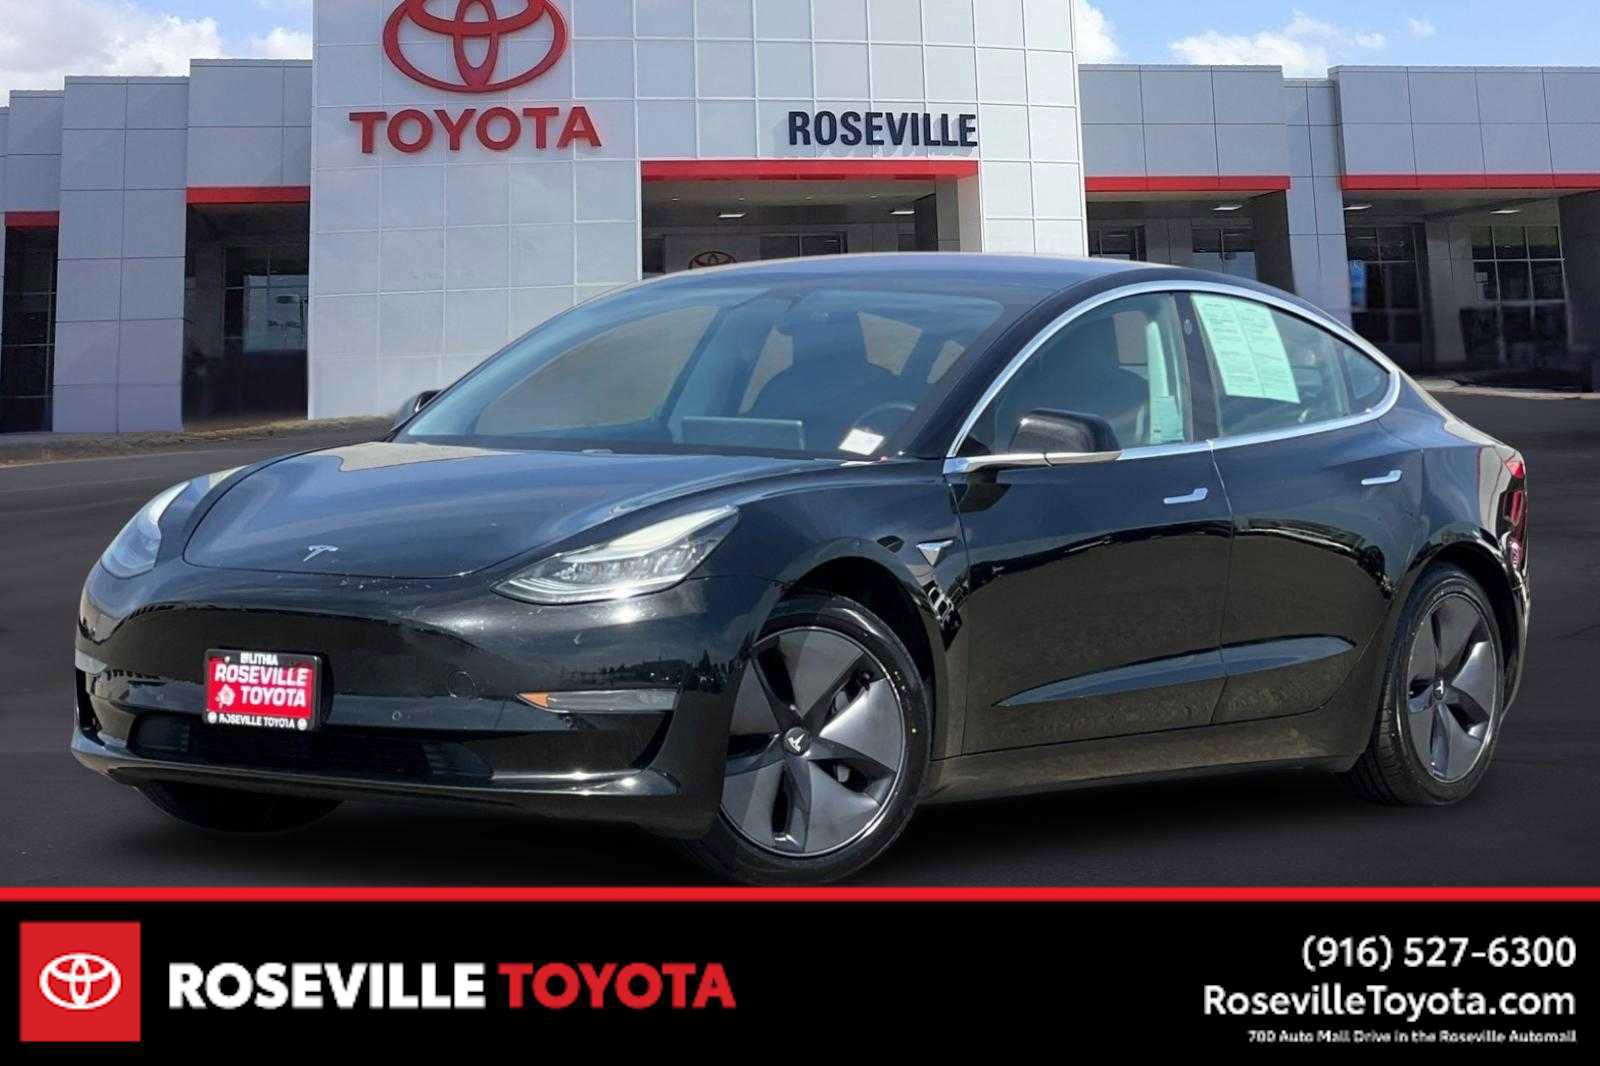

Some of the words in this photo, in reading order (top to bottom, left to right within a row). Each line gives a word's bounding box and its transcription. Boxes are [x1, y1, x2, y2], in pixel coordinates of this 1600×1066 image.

[349, 105, 602, 154] TOYOTA
[788, 110, 979, 147] ROSEVILLE
[214, 664, 309, 686] ROSEVILLE
[240, 686, 307, 707] TOYOTA
[218, 714, 262, 726] ROSEVILLE
[264, 716, 295, 729] TOYOTA
